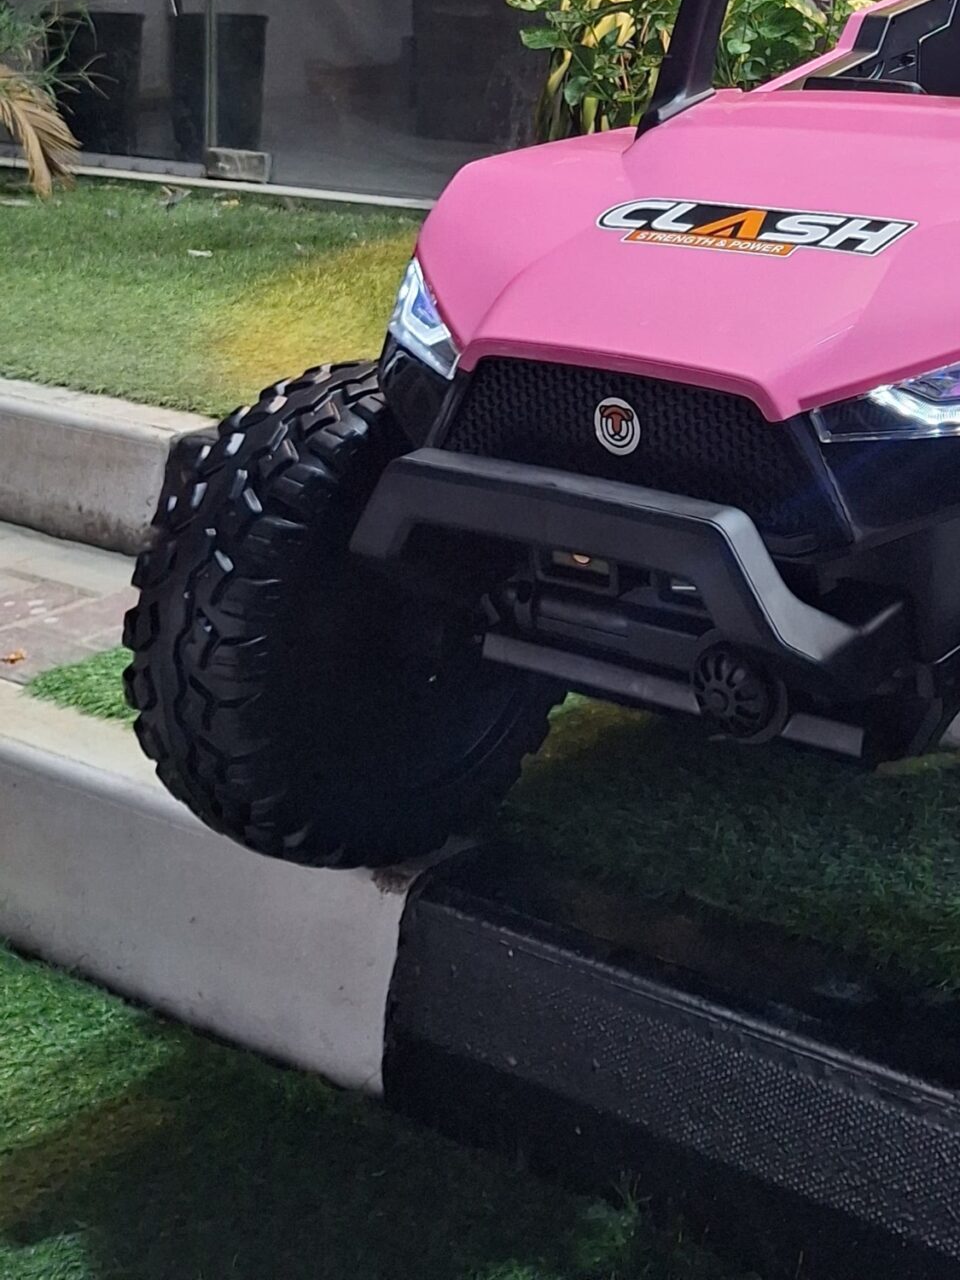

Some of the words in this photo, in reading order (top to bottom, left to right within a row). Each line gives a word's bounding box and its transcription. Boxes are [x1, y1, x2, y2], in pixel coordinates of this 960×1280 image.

[602, 200, 908, 252] CLASH
[636, 231, 715, 247] STRENGTH
[715, 239, 727, 247] &
[730, 239, 784, 253] POWER
